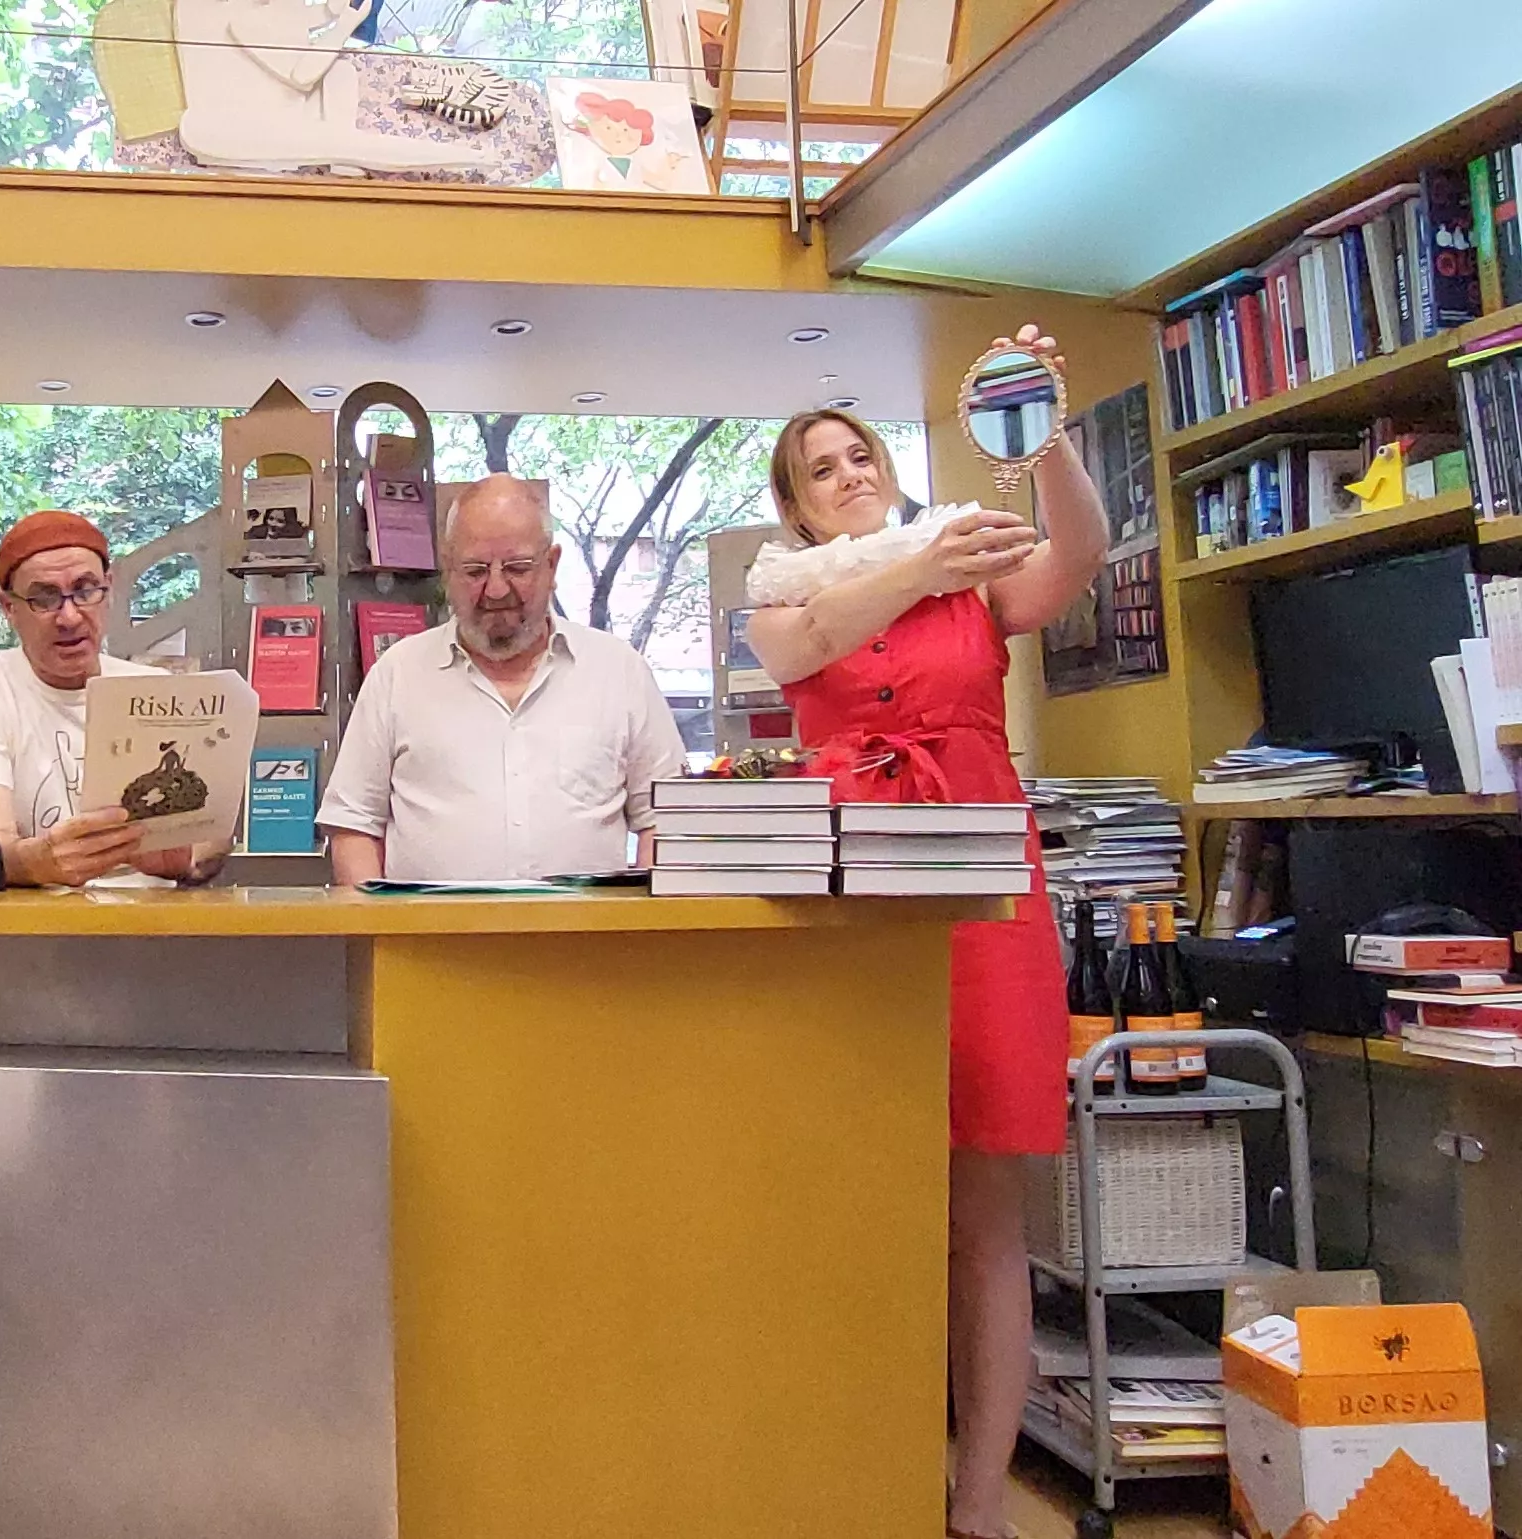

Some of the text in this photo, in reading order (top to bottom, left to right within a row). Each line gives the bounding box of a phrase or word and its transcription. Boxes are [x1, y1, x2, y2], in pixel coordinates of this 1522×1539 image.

[129, 694, 226, 717] Risk All
[1339, 1392, 1459, 1418] BORSAO
